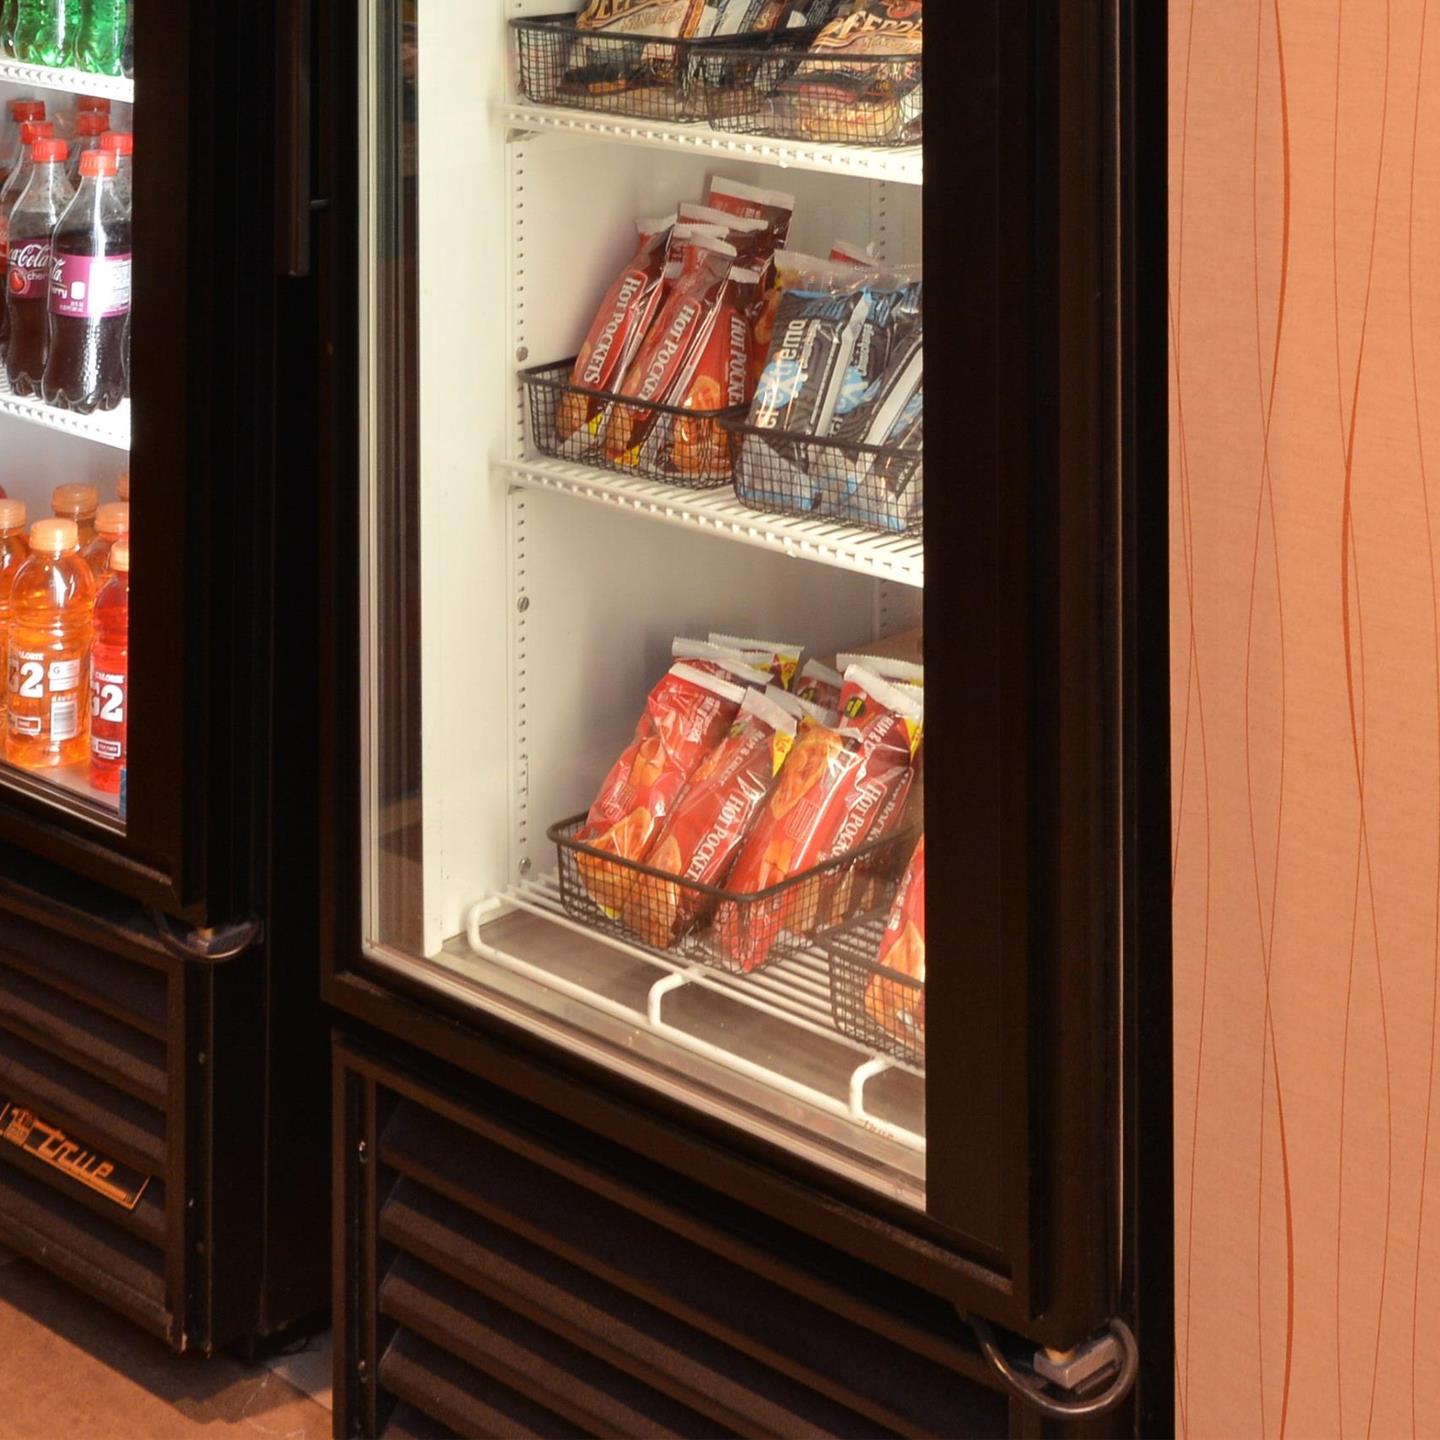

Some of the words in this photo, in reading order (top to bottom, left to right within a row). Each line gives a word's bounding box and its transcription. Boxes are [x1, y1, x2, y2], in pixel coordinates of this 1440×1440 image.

[27, 271, 48, 281] cher
[619, 274, 642, 310] HOT
[671, 303, 695, 341] HOT
[584, 309, 629, 386] POCKETS
[728, 345, 747, 406] POCKE
[721, 793, 745, 827] HOT
[855, 781, 882, 816] HOT
[685, 827, 728, 883] POCKET
